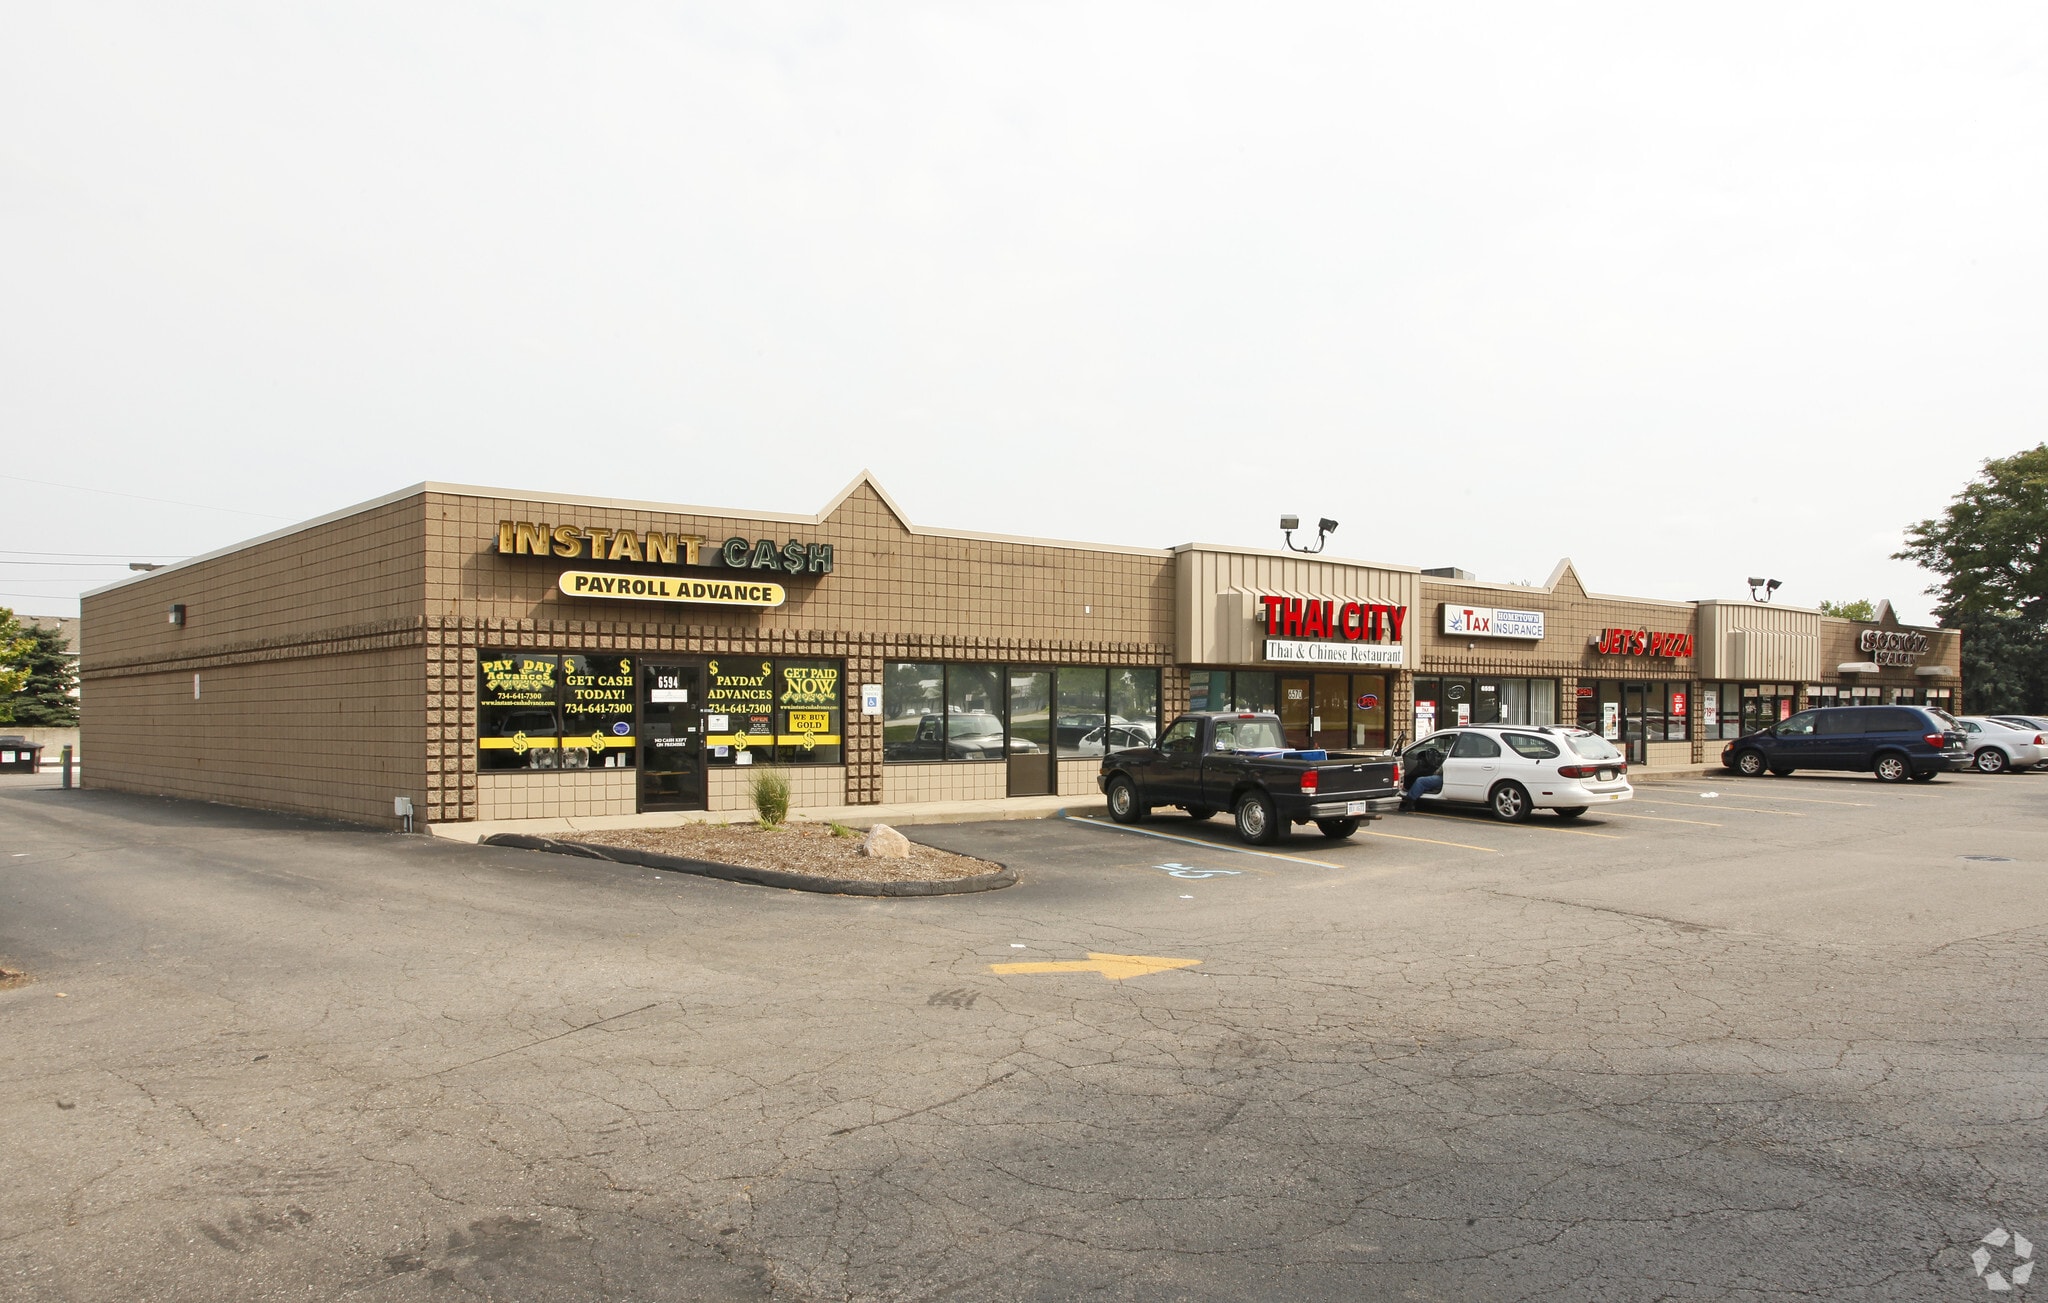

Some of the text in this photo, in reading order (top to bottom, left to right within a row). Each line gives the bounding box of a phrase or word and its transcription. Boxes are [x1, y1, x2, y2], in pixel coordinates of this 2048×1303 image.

[499, 520, 706, 565] INSTANT
[575, 576, 772, 602] PAYROLL ADVANCE
[1261, 595, 1407, 641] THAI CITY
[1497, 612, 1539, 623] HOMETOWN
[1494, 622, 1543, 636] INSURANCE
[1599, 628, 1694, 657] JET'S PIZZA
[1269, 641, 1401, 662] Thai & Chinese Restaurant
[482, 659, 555, 674] PAY DAY
[784, 668, 838, 679] GET PAID
[566, 676, 633, 686] GET CASH
[658, 676, 679, 688] 6594
[717, 676, 764, 686] PAYDAY
[786, 678, 837, 695] NOW
[575, 689, 625, 699] TODAY!
[708, 690, 772, 699] ADVANCES
[565, 704, 633, 713] 734-641-7300
[708, 704, 771, 713] 734-641-7300
[796, 721, 822, 729] GOLD
